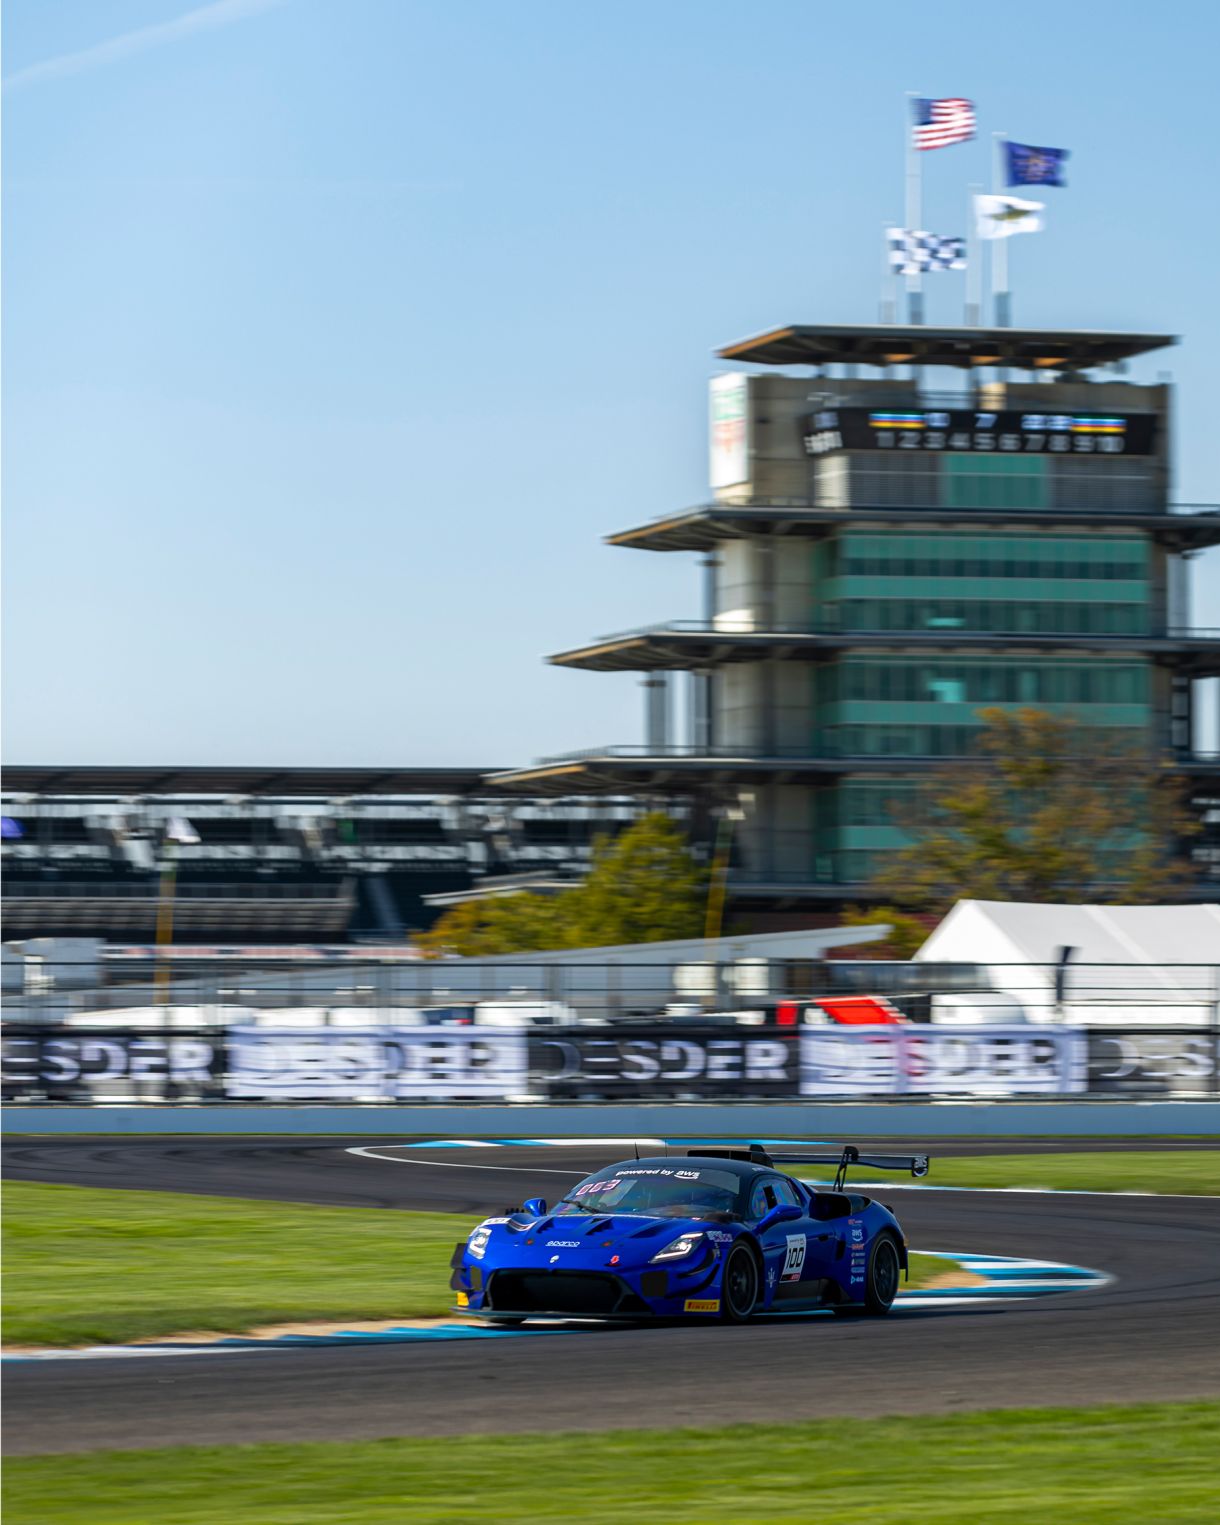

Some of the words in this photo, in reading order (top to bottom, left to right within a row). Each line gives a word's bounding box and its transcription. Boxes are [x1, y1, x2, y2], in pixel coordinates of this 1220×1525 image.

[541, 1040, 789, 1080] DESDER
[674, 1171, 701, 1180] aws
[785, 1247, 805, 1269] 100
